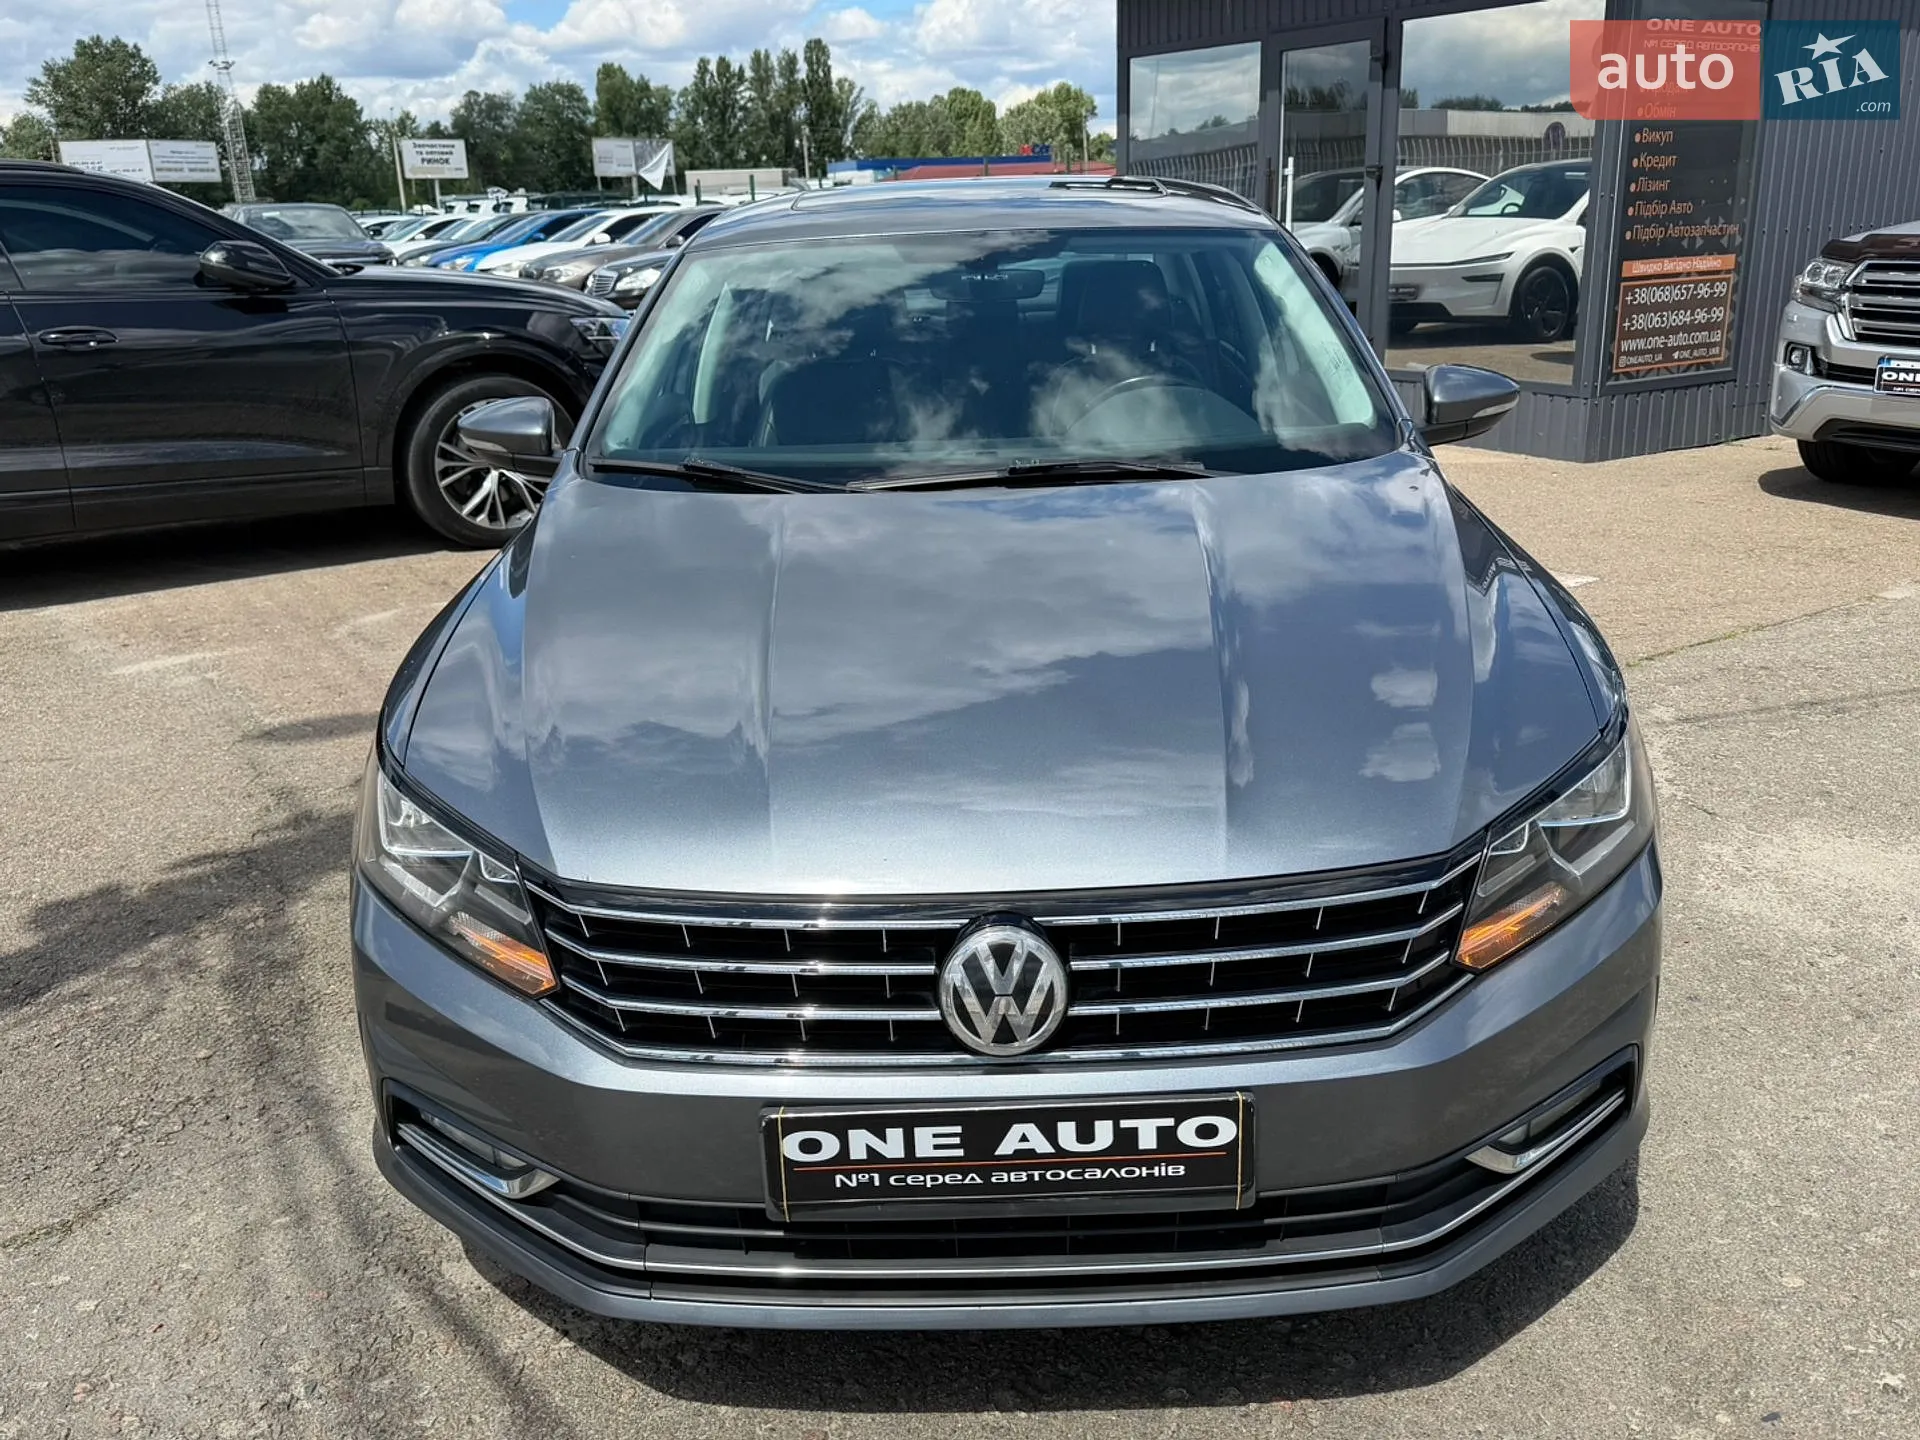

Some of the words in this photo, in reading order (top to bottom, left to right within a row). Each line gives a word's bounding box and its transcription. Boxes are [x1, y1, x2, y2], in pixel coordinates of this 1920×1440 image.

[1646, 18, 1695, 32] ONE
[1700, 21, 1761, 36] AUTO
[1644, 102, 1677, 119] Обмін
[1641, 127, 1674, 146] Викуп
[420, 157, 451, 165] РИНОК
[1639, 152, 1677, 170] Кредит
[1636, 176, 1671, 192] Лізинг
[1634, 200, 1668, 219] Підбір
[1669, 199, 1694, 215] Авто
[1632, 225, 1665, 244] Підбір
[1666, 222, 1740, 238] Автозапчастин
[1625, 281, 1727, 304] +38(068)657-96-99
[1622, 306, 1725, 332] +38(063)684-96-99
[1621, 330, 1721, 352] www.one-auto.com.ua
[782, 1124, 964, 1163] ONE
[994, 1115, 1237, 1156] AUTO
[835, 1172, 880, 1188] №1
[889, 1171, 984, 1187] серед
[992, 1163, 1186, 1183] автосалонів
